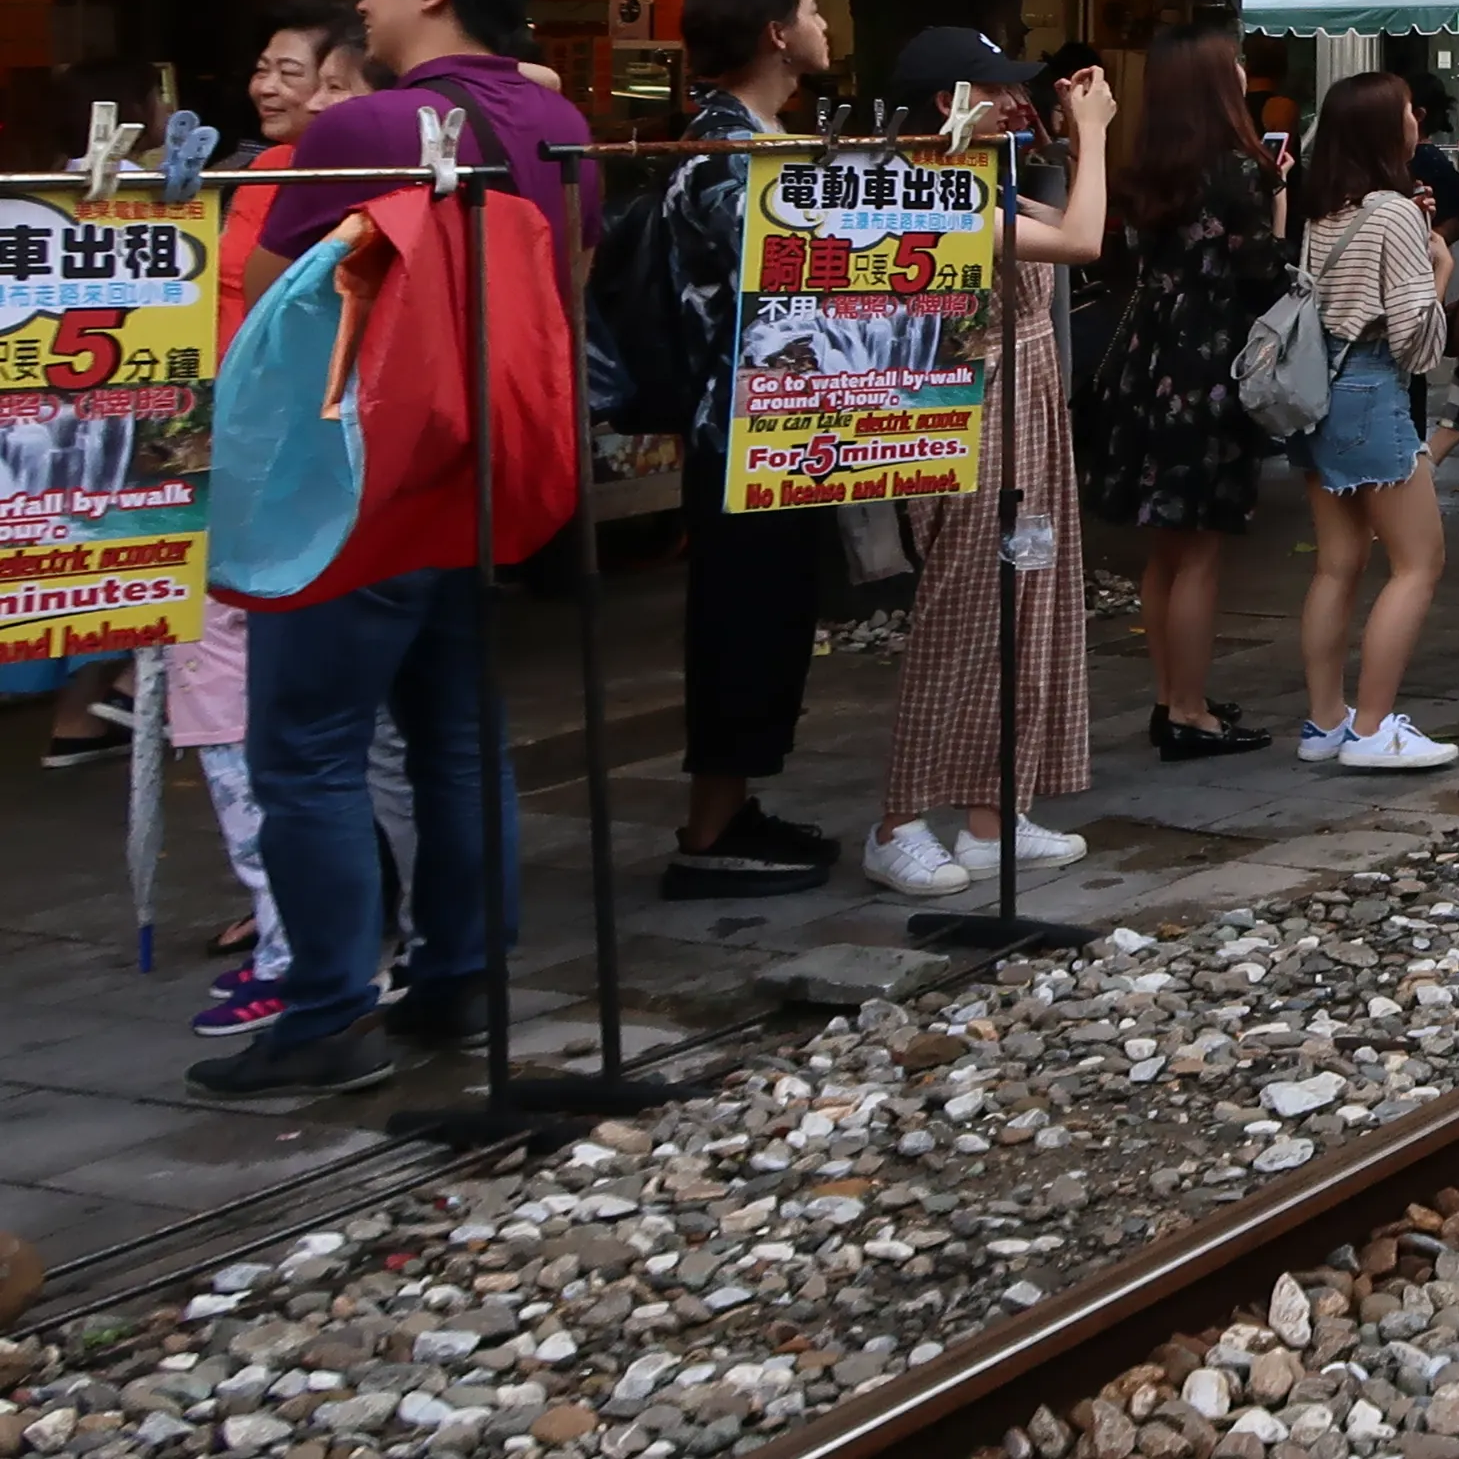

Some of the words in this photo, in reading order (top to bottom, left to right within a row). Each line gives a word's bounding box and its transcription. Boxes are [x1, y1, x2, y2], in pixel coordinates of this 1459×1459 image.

[780, 163, 974, 211] 電動車出租
[0, 224, 181, 282] 車出租
[0, 282, 183, 307] 布走路來回1小時
[752, 377, 780, 392] Go
[784, 375, 805, 391] to
[812, 371, 897, 390] waterfall
[902, 371, 925, 390] by
[930, 367, 972, 385] walk
[750, 393, 820, 410] around
[748, 415, 775, 432] You
[783, 415, 811, 431] can
[818, 411, 854, 428] take
[748, 447, 803, 470] For
[802, 434, 838, 475] 5
[841, 438, 967, 463] minutes.
[73, 491, 109, 516] by
[119, 483, 193, 509] walk
[746, 482, 774, 510] No
[852, 472, 887, 500] and
